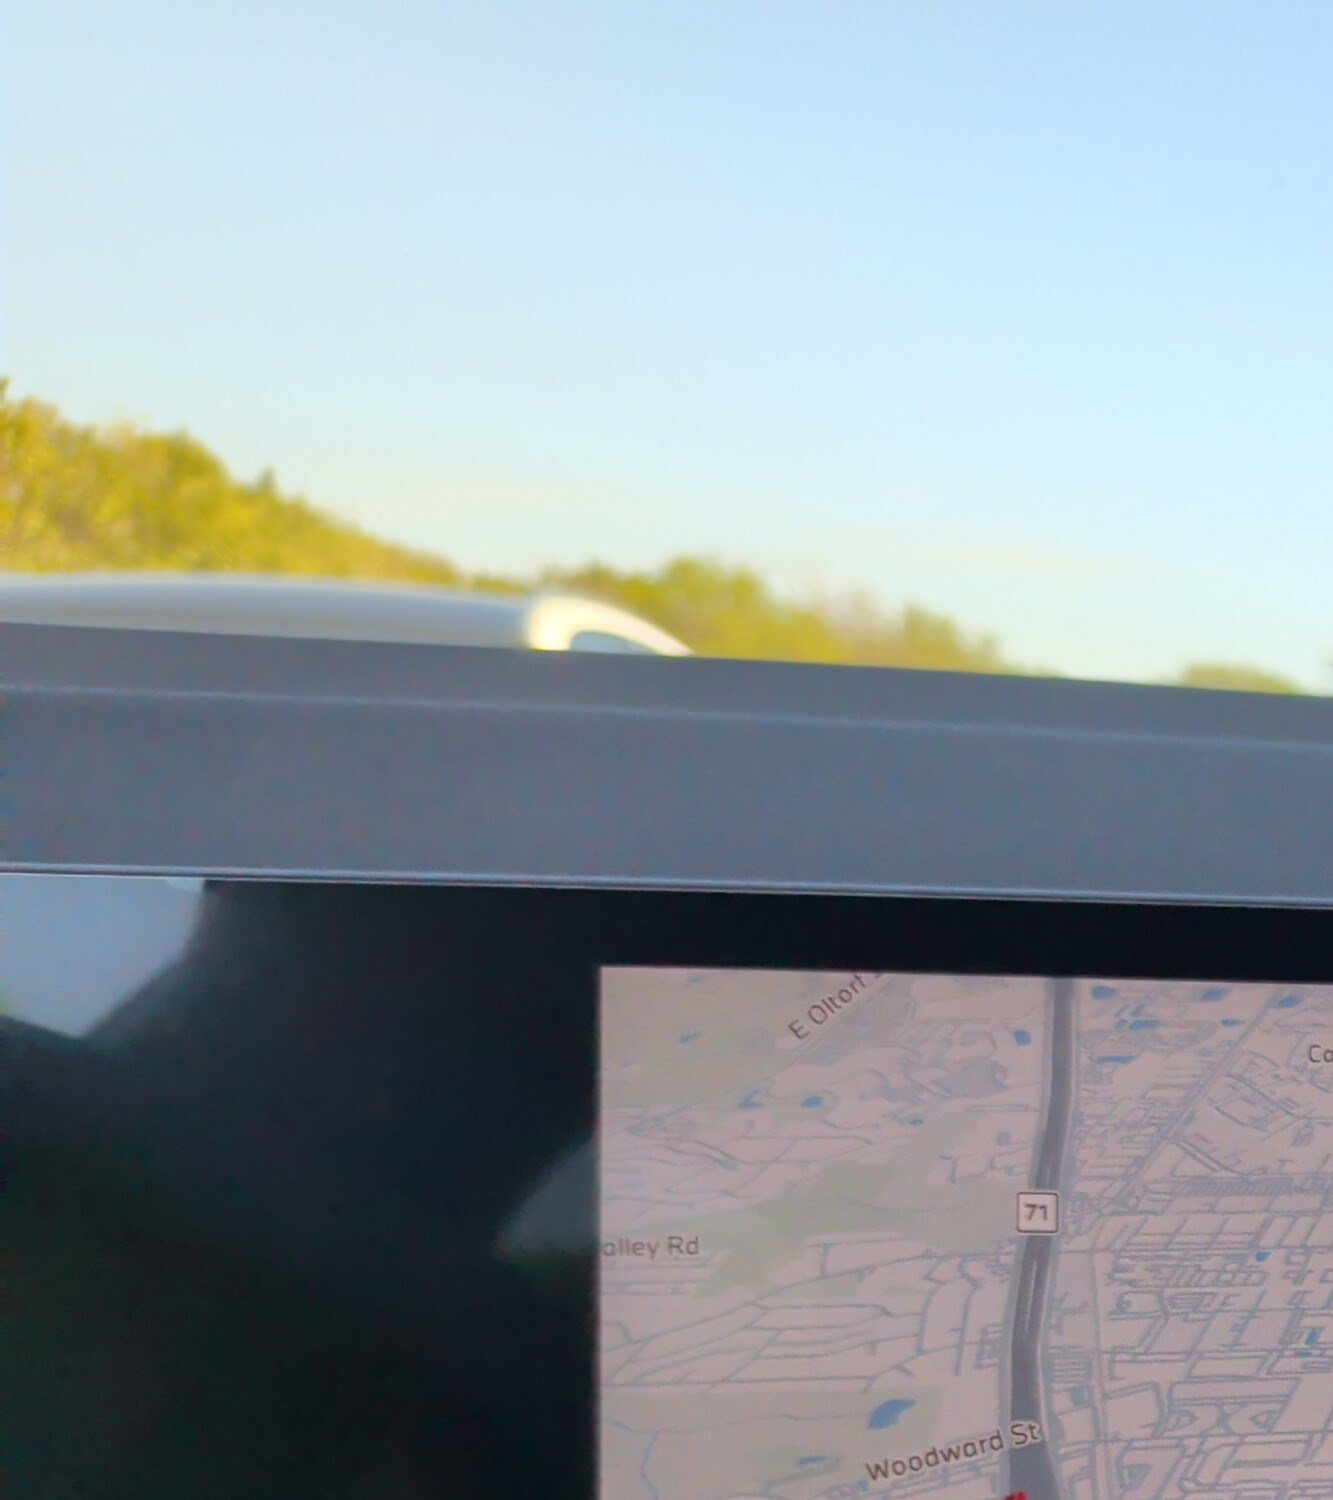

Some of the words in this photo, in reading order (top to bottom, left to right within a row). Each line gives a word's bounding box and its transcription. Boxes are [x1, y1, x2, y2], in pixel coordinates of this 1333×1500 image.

[1025, 1203, 1050, 1222] 71
[602, 1237, 660, 1261] alley
[668, 1235, 699, 1255] Rd
[865, 1430, 1005, 1483] Woodward
[1010, 1423, 1042, 1448] St
